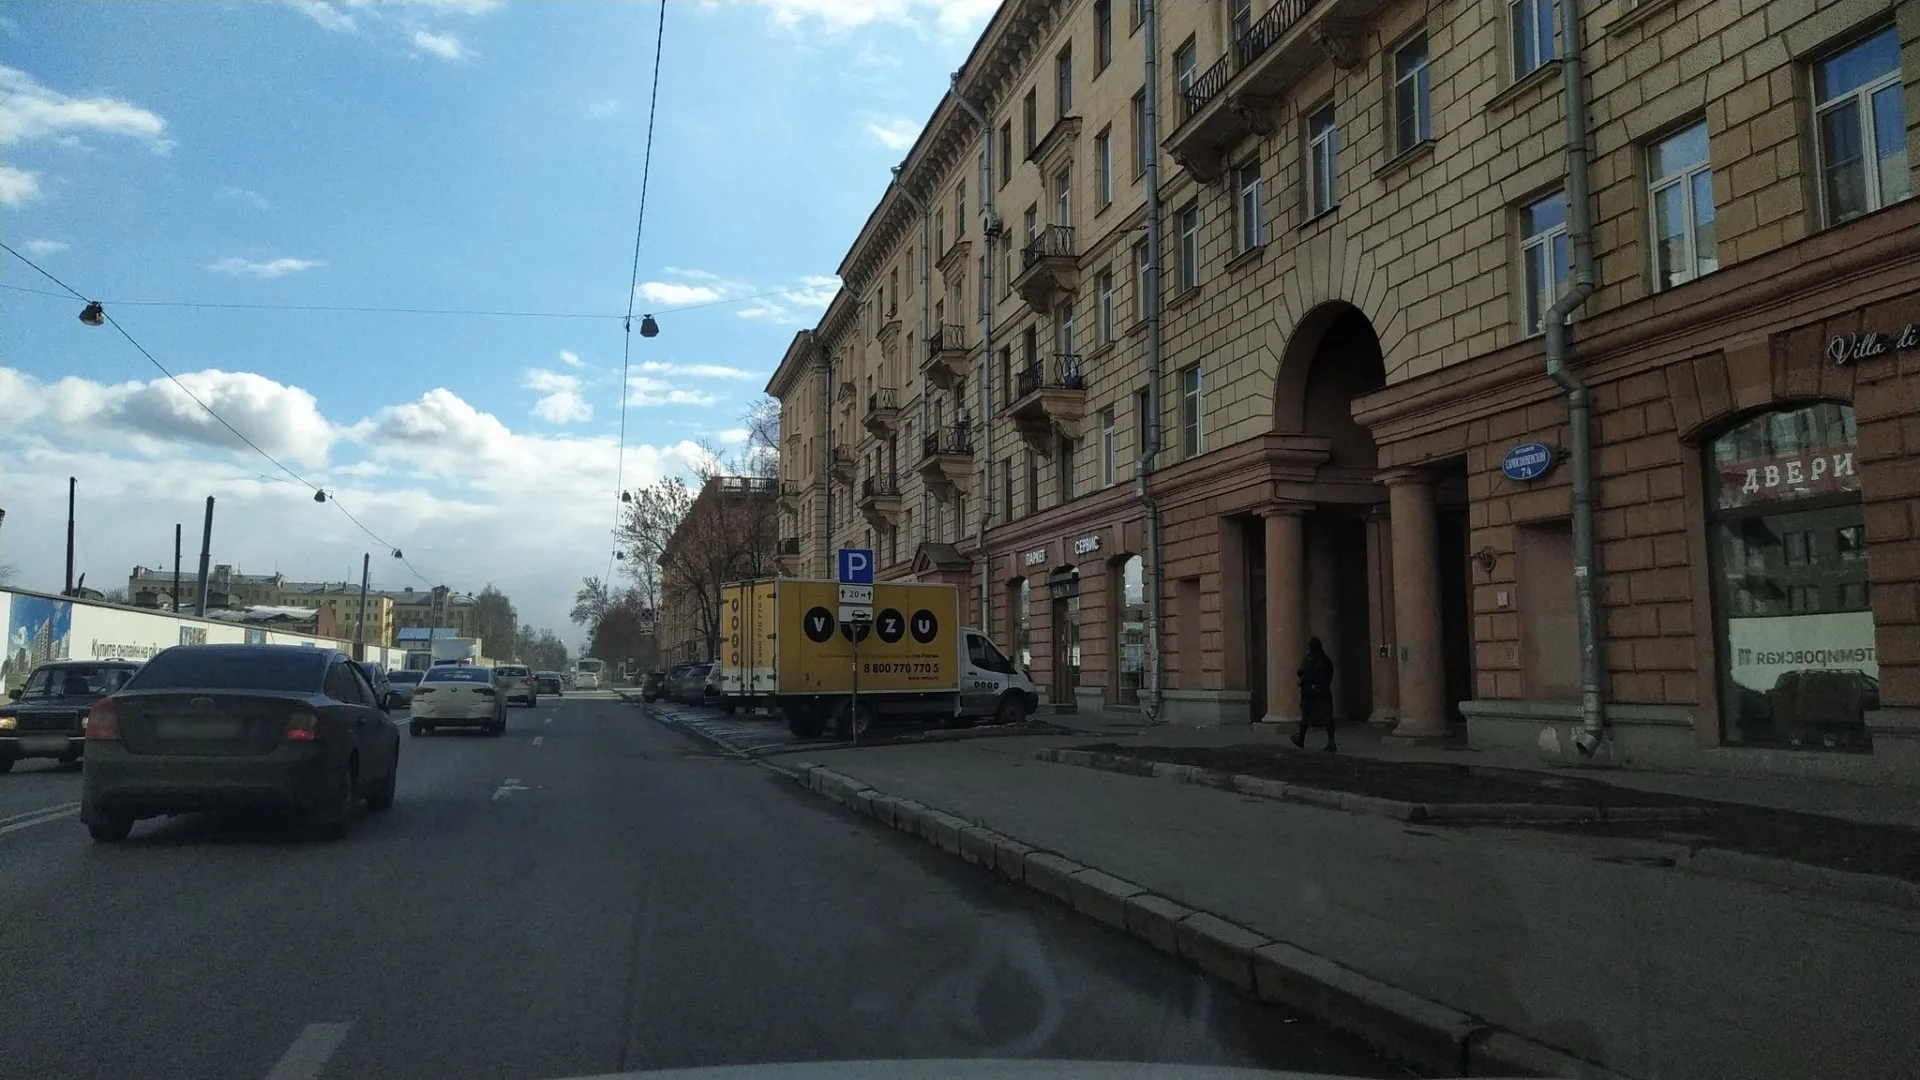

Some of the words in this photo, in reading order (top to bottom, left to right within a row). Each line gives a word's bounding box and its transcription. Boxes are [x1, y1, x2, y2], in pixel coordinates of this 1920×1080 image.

[1827, 331, 1886, 364] Villa
[1896, 324, 1917, 348] di
[1520, 466, 1532, 477] 74
[1742, 452, 1854, 494] ДВЕРИ
[1026, 549, 1046, 566] ПАРКЕТ
[1074, 535, 1099, 555] СЕРВИС
[847, 552, 867, 580] P
[849, 590, 860, 598] 20
[91, 638, 116, 661] Купите
[117, 641, 140, 658] онлайн
[141, 645, 148, 659] на
[863, 663, 870, 673] 8
[872, 663, 891, 673] 800
[893, 664, 911, 673] 770
[914, 664, 931, 673] 770
[933, 664, 939, 673] 5
